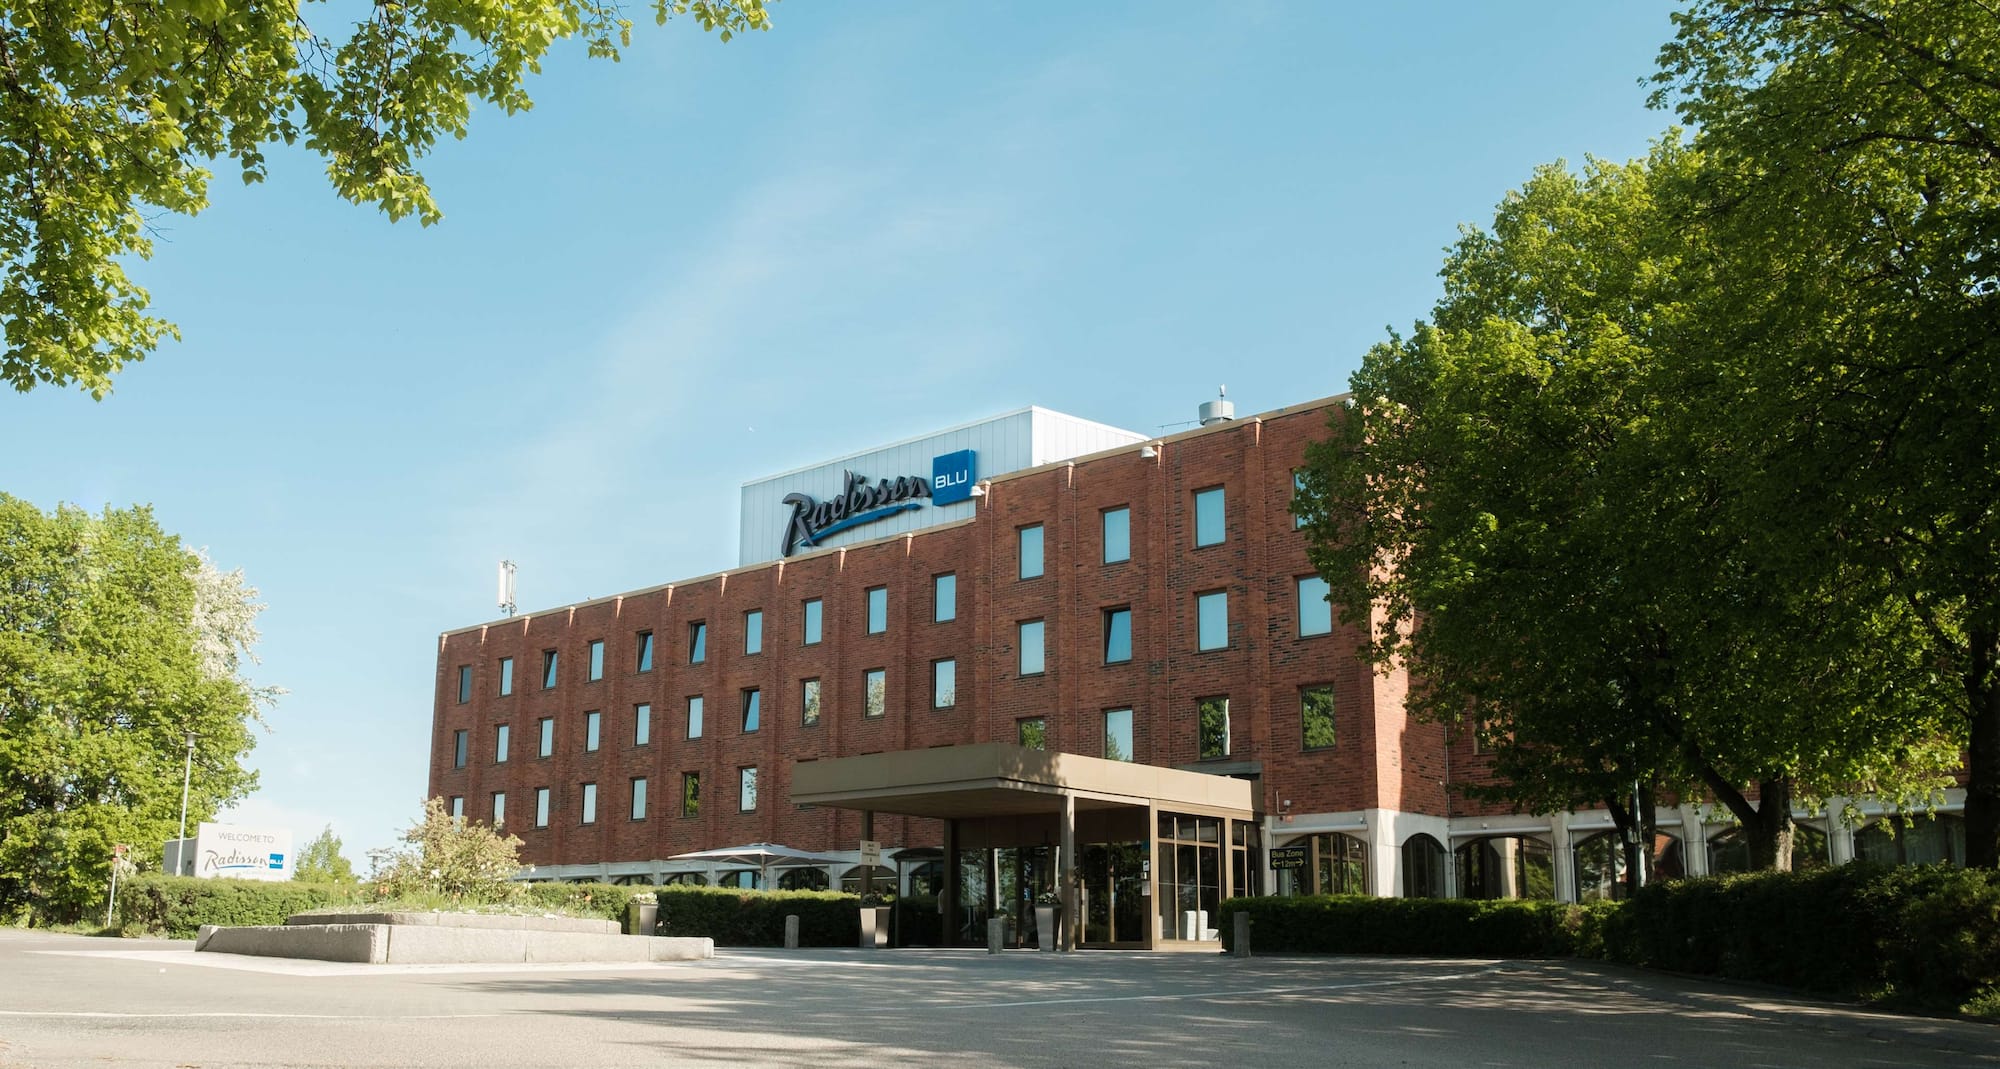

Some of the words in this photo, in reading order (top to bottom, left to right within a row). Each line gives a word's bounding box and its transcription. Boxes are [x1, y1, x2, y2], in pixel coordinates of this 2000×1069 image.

[781, 469, 933, 557] Radisson
[935, 470, 967, 489] BLU
[218, 832, 261, 842] WELCOME
[262, 835, 275, 844] TO
[204, 848, 267, 872] Radisson
[1271, 850, 1285, 858] Bus
[1286, 850, 1304, 858] Zone
